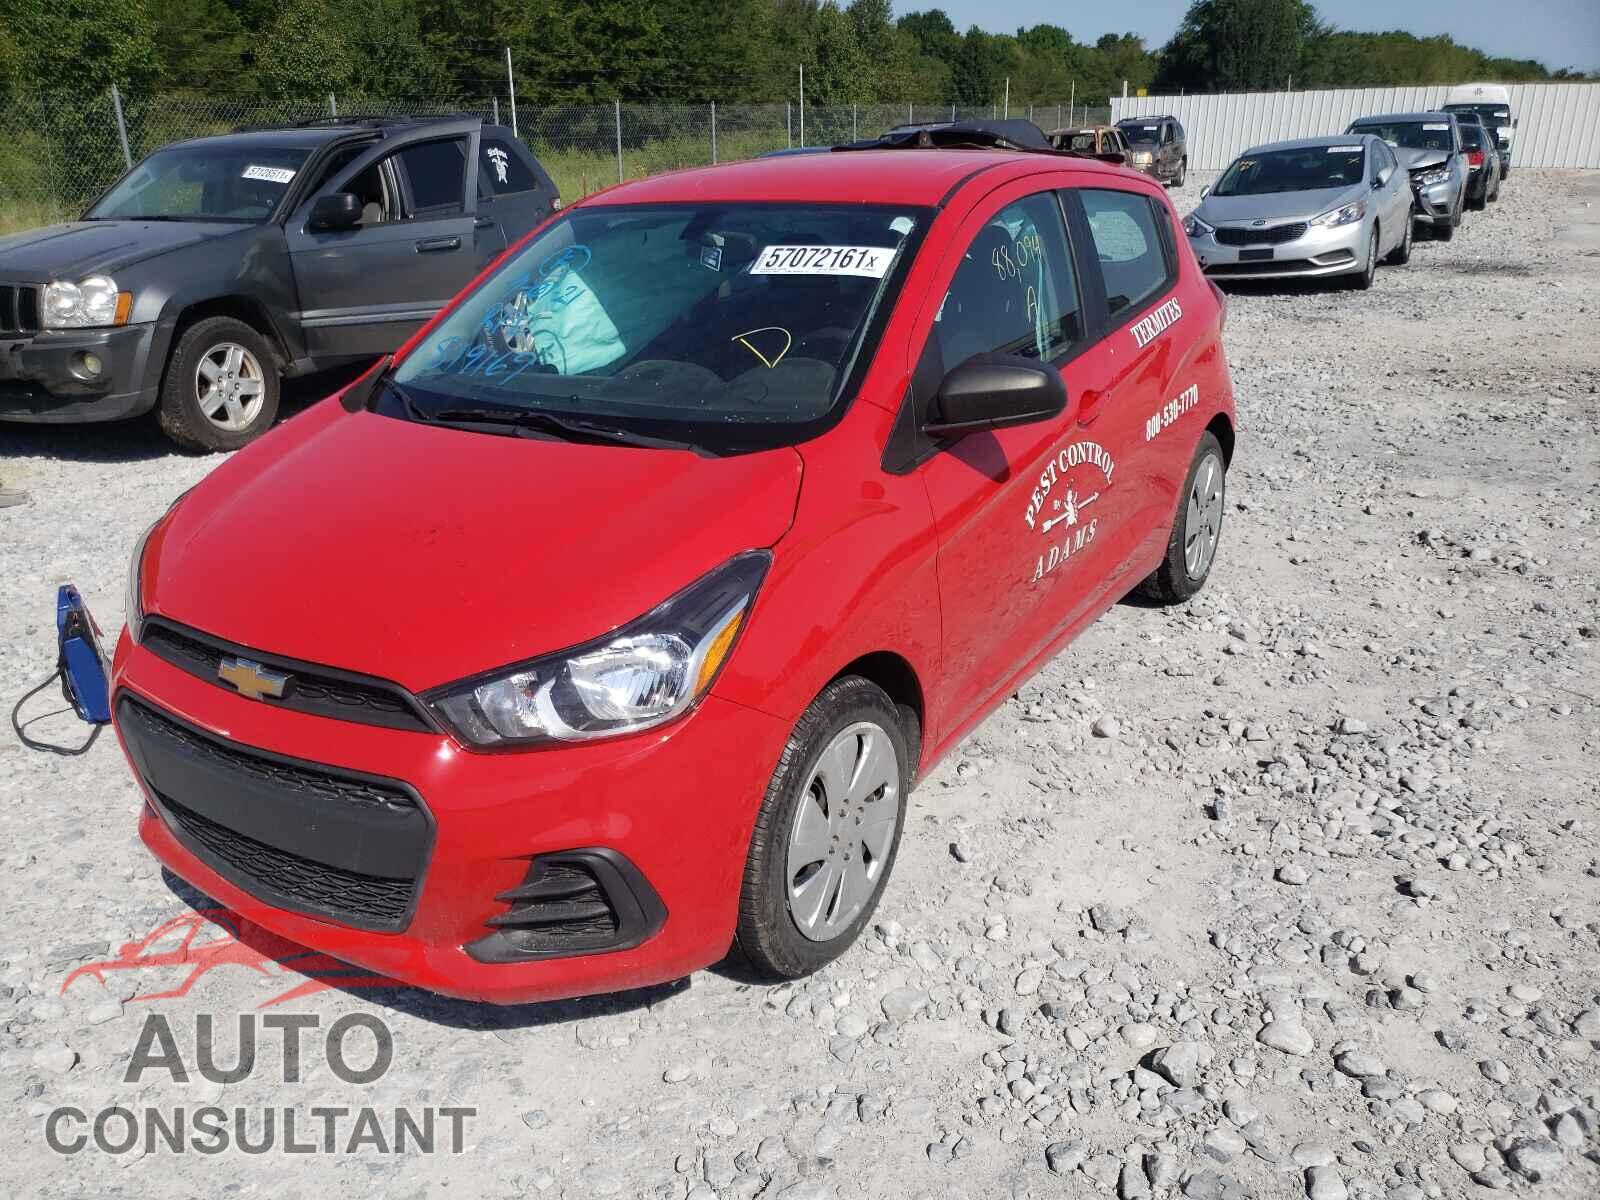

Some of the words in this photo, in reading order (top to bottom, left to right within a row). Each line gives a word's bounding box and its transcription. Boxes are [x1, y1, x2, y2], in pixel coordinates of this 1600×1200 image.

[1129, 297, 1182, 348] TERMITES
[1145, 384, 1198, 442] 800-530-7770
[1025, 460, 1058, 529] PEST
[1059, 441, 1115, 485] CONTROL
[1032, 519, 1097, 582] ADAMS
